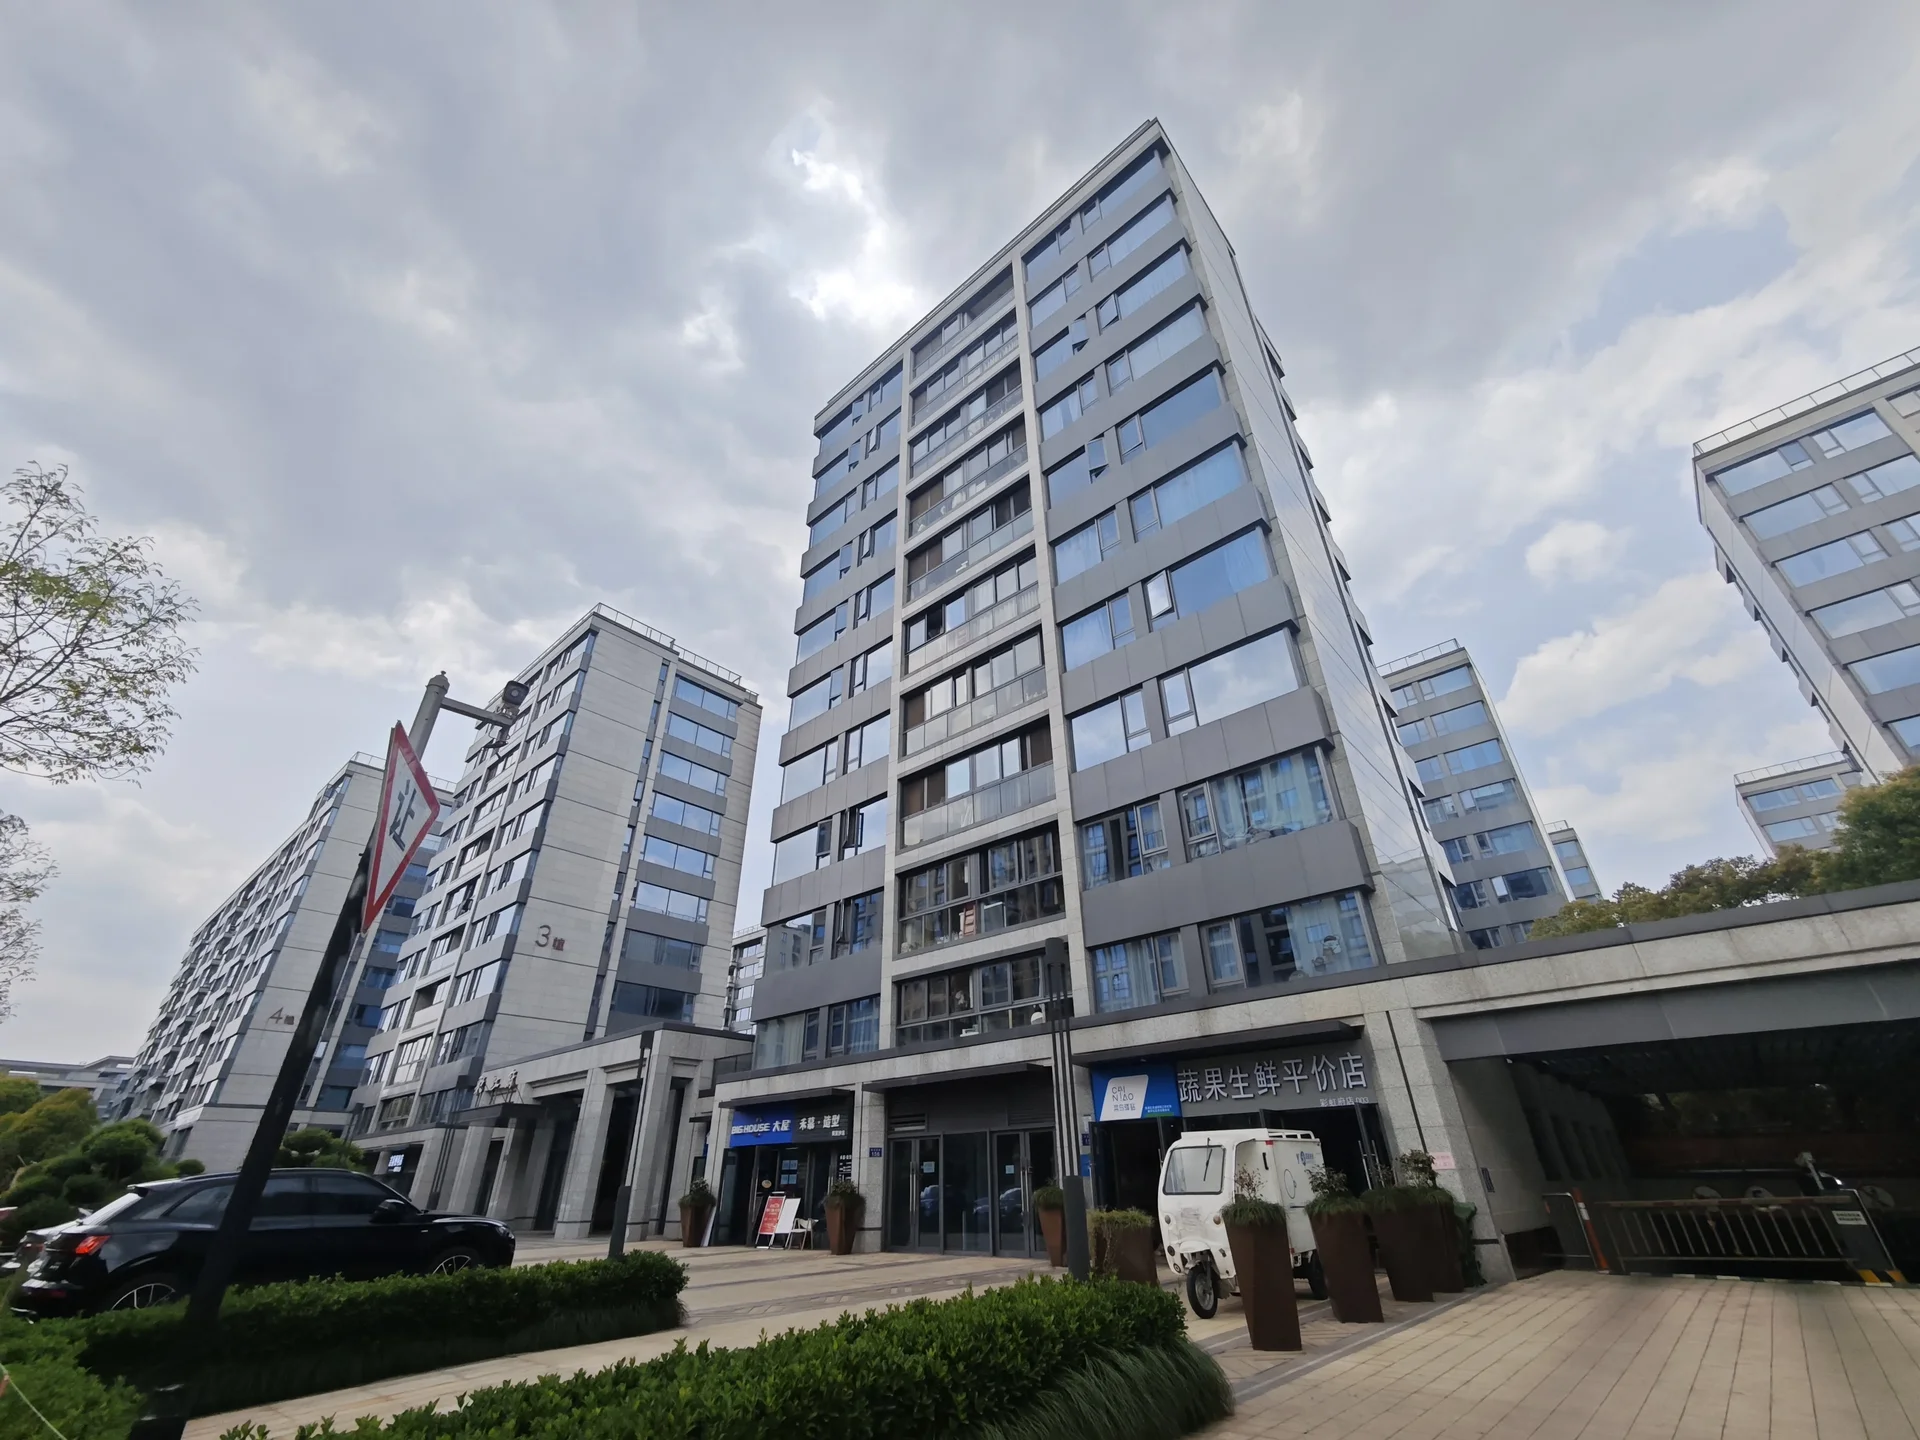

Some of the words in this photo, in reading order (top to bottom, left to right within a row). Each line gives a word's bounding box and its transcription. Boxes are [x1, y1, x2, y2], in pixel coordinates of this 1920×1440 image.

[389, 779, 416, 851] 让
[1177, 1052, 1367, 1103] 蔬果生鲜平价店
[772, 1119, 791, 1132] 大屋
